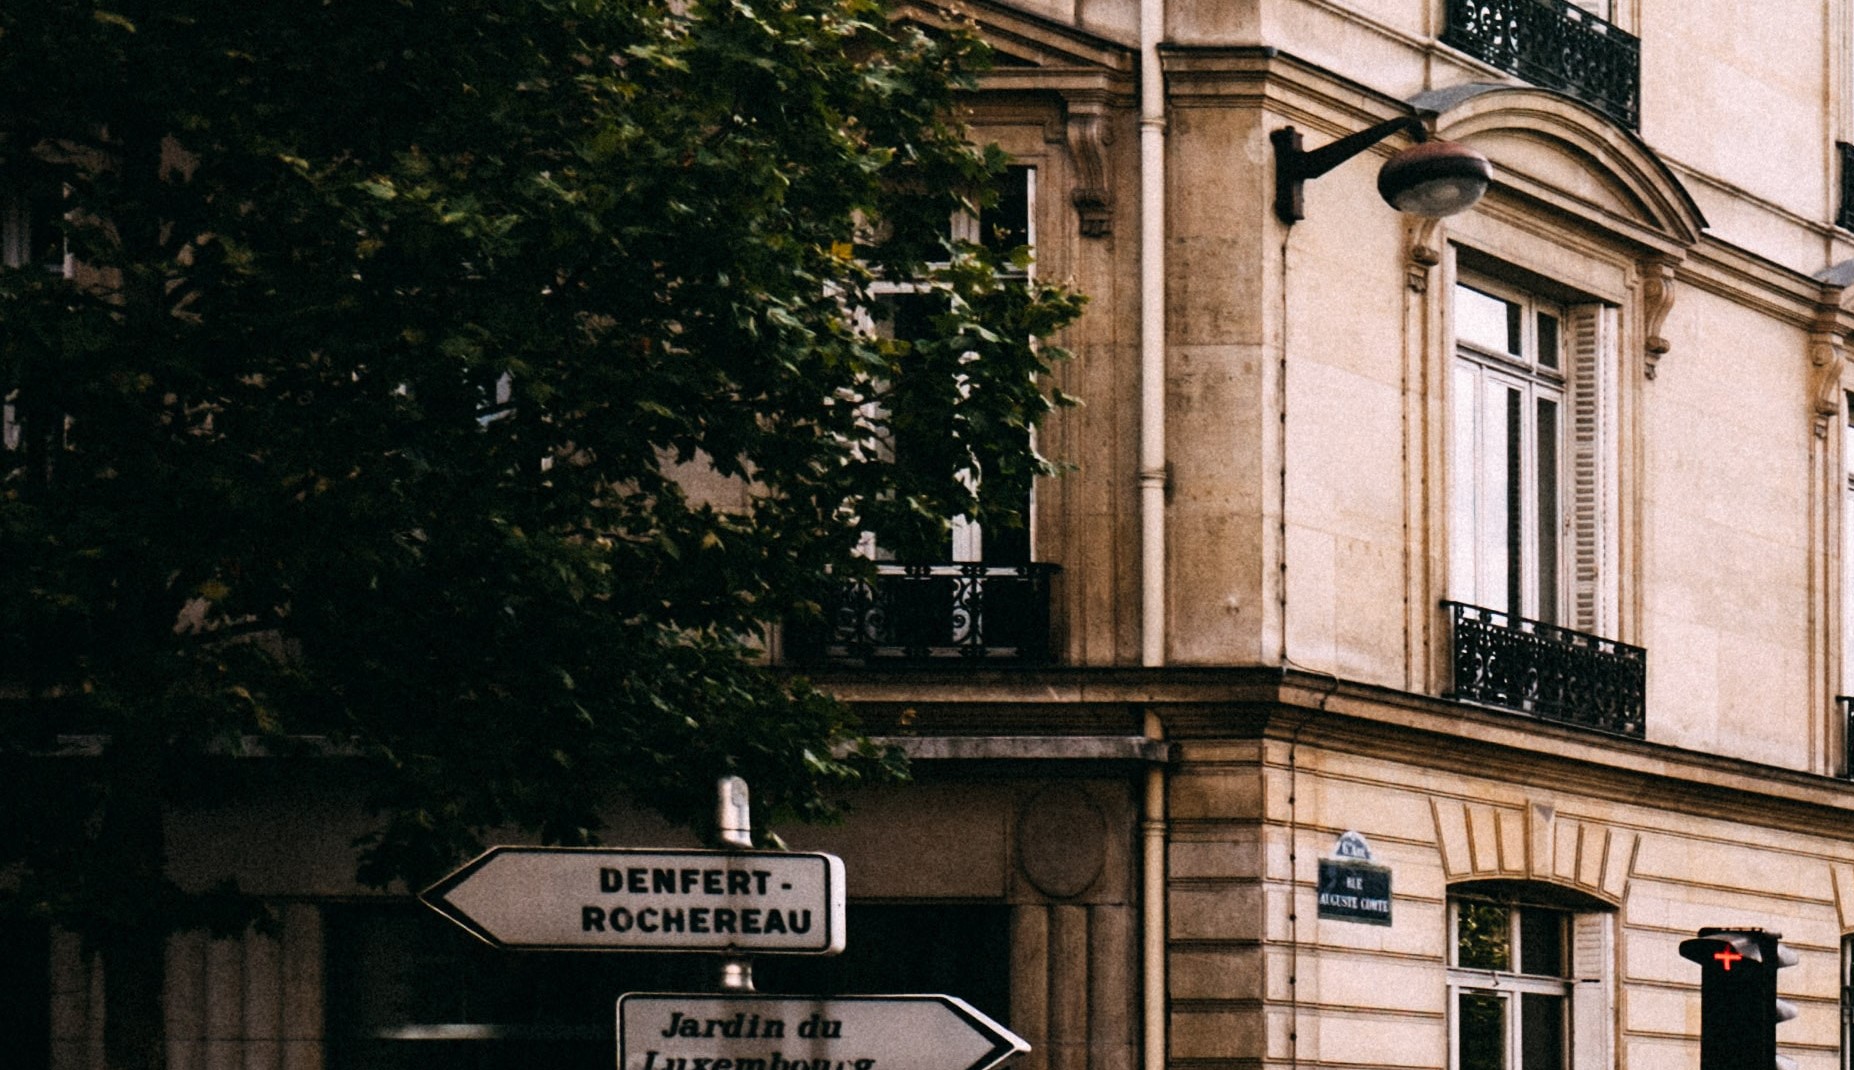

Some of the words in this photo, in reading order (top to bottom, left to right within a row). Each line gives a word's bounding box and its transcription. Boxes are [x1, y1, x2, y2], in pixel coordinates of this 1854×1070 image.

[600, 867, 771, 895] DENFERT
[582, 906, 811, 934] ROCHEREAU
[661, 1012, 785, 1038] Jardin
[798, 1014, 842, 1039] du
